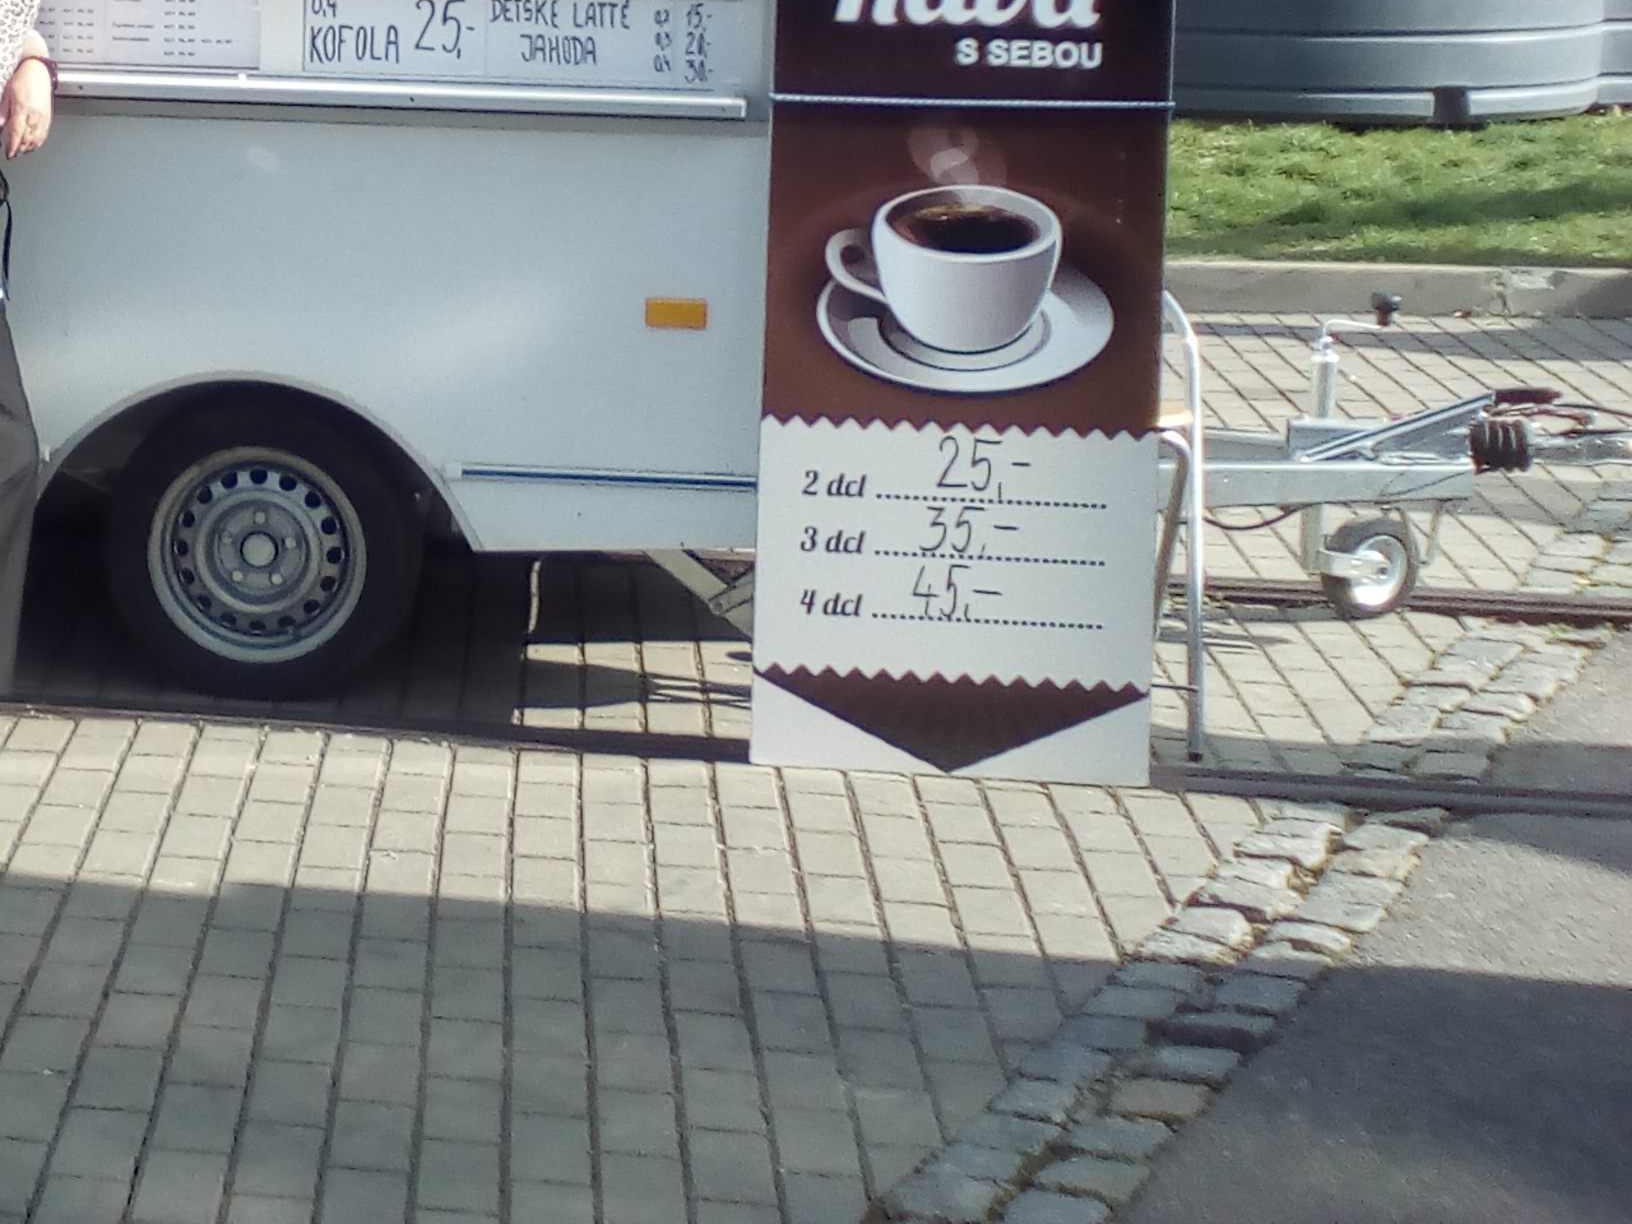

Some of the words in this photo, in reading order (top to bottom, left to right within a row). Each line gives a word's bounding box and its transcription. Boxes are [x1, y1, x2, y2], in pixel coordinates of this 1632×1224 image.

[310, 24, 400, 65] KOFOLA
[521, 33, 598, 67] JAHODA
[955, 37, 980, 66] S
[986, 39, 1104, 70] SEBOU
[801, 470, 819, 497] 2
[827, 473, 867, 499] dcl
[800, 526, 818, 553] 3
[825, 530, 866, 555] dcl
[800, 589, 817, 615] 4
[823, 593, 863, 618] dcl
